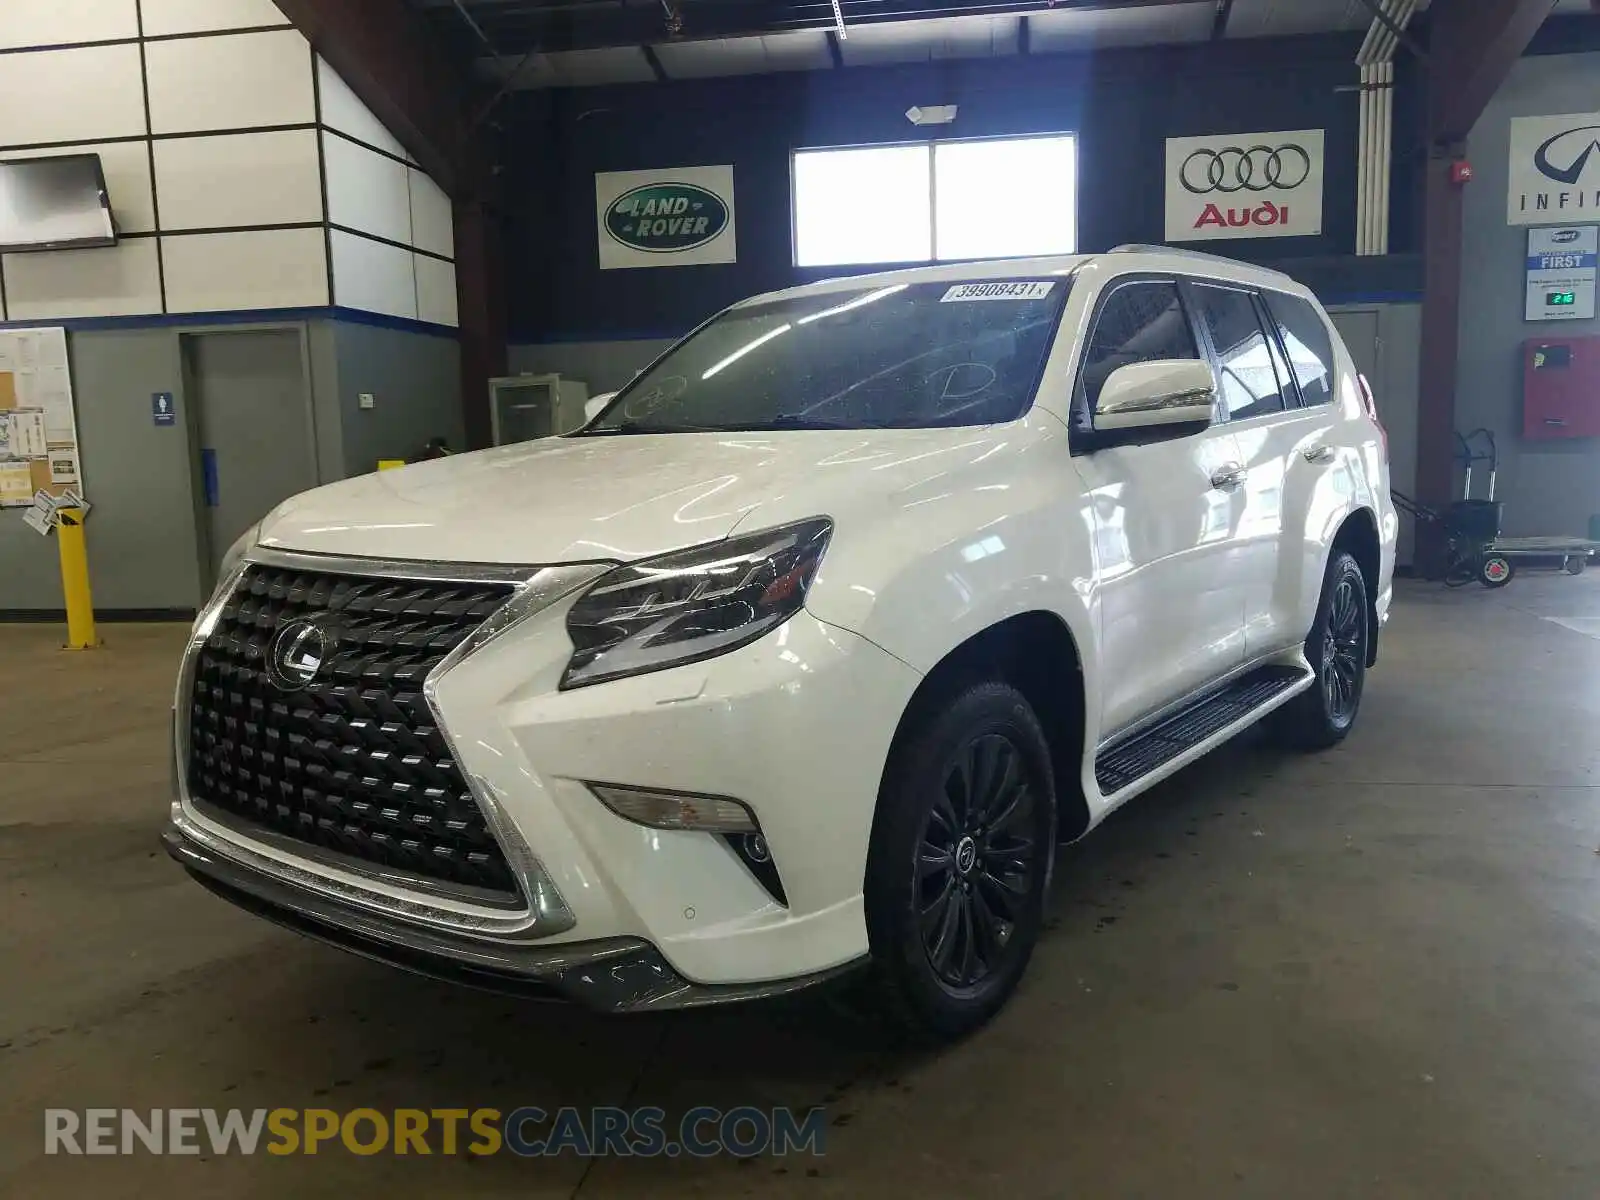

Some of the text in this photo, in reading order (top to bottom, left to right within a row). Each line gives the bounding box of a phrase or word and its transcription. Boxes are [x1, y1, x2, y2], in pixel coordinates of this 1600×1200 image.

[630, 197, 689, 217] LAND
[636, 216, 710, 237] ROVER
[1541, 255, 1583, 269] FIRST
[955, 283, 1038, 298] 39908431
